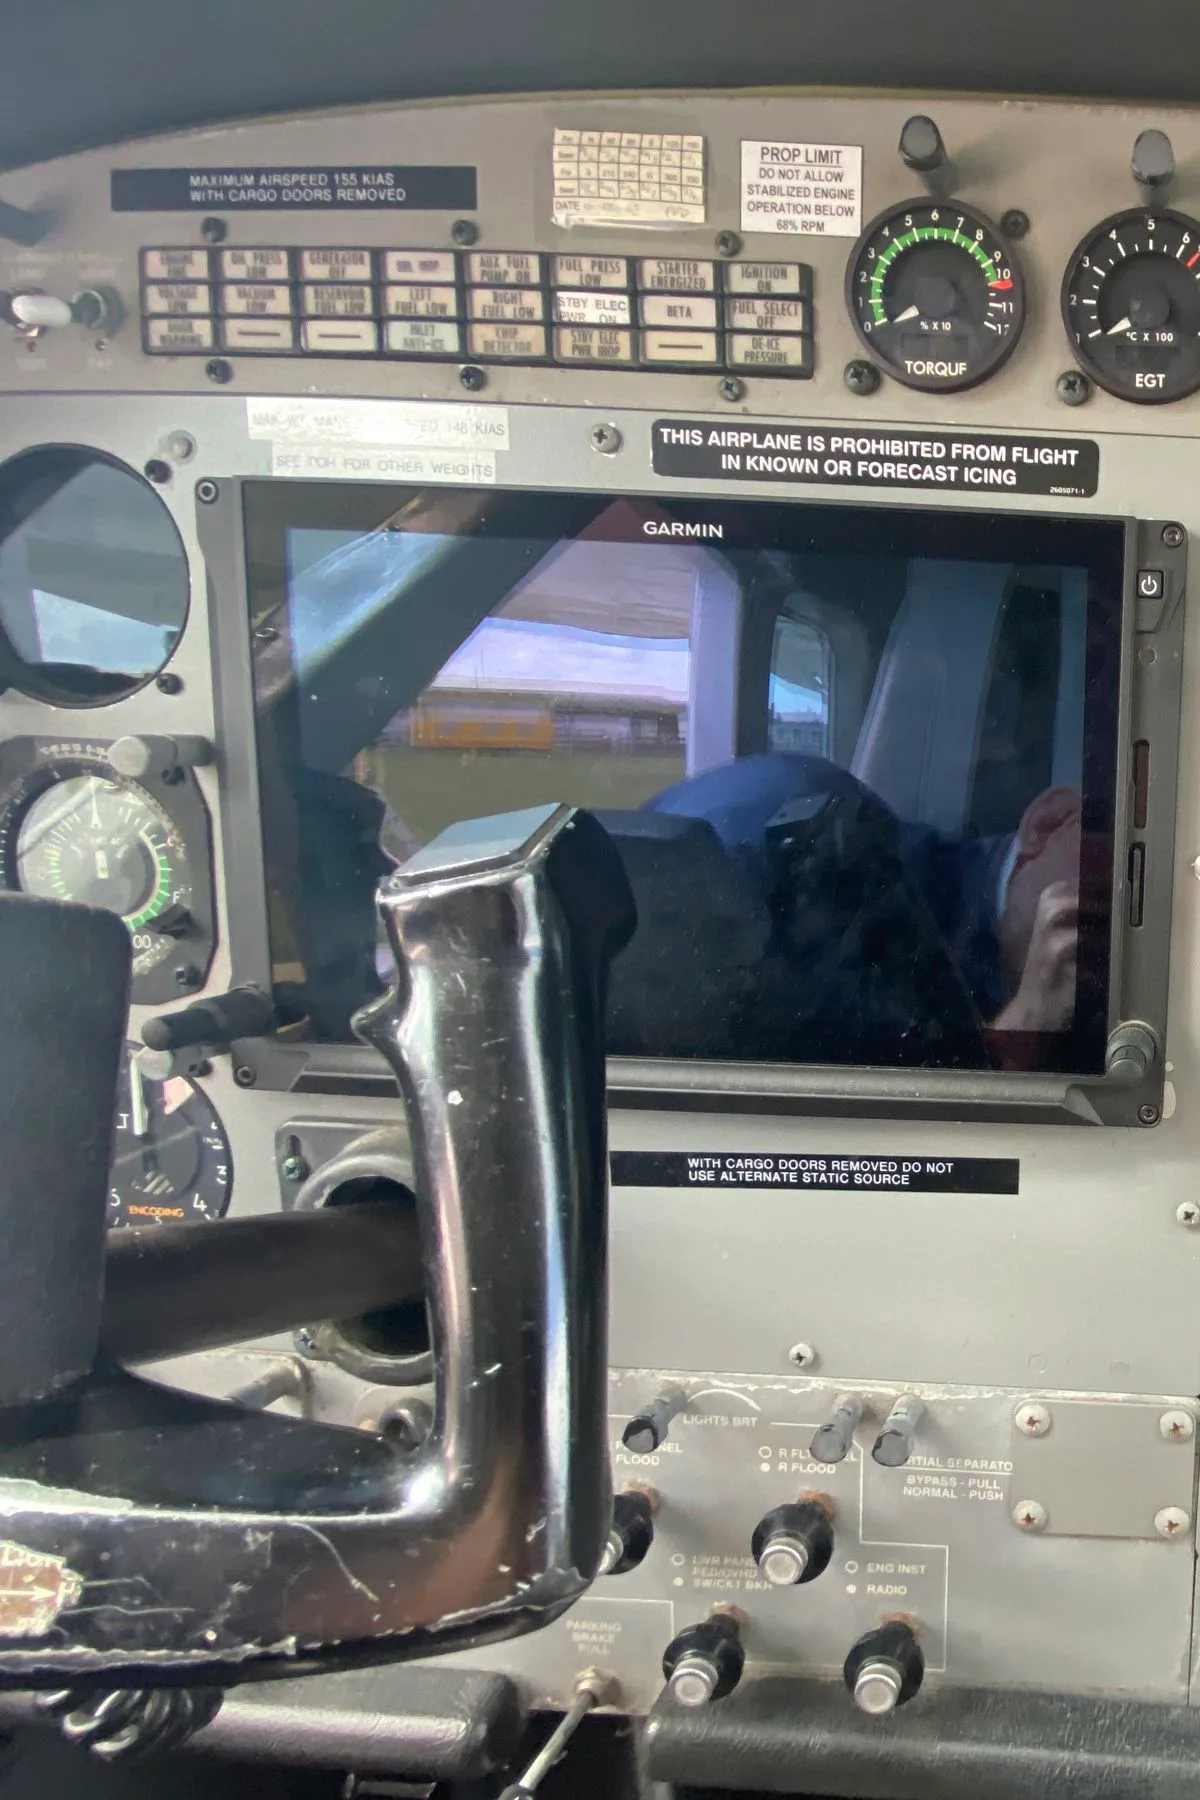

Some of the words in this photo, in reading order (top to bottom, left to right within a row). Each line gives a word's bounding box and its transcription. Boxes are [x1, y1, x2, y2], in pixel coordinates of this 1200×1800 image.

[761, 147, 800, 161] PROP
[805, 149, 842, 164] LIMIT
[189, 175, 254, 186] MAXIMUM
[259, 174, 327, 186] AIRSPEED
[333, 174, 357, 185] 155
[362, 173, 394, 185] KIAS
[759, 168, 775, 179] DO
[778, 169, 800, 180] NOT
[804, 170, 843, 182] ALLOW
[190, 190, 223, 201] WITH
[228, 189, 277, 201] CARGO
[282, 189, 332, 201] DOORS
[337, 189, 406, 201] REMOVED
[747, 184, 811, 198] STABILIZED
[814, 188, 855, 200] ENGINE
[747, 201, 811, 215] OPERATION
[814, 204, 855, 217] BELOW
[776, 220, 798, 231] 68%
[801, 221, 824, 232] RPM
[559, 261, 583, 273] FUEL
[591, 261, 621, 274] PRESS
[657, 262, 699, 275] STARTER
[741, 266, 788, 280] IGNITION
[579, 273, 600, 285] LOW
[651, 276, 706, 290] ENERGIZED
[757, 280, 772, 293] ON
[558, 296, 588, 308] STBY
[595, 299, 626, 311] ELEC
[733, 302, 758, 315] FUEL
[764, 303, 799, 317] SELECT
[560, 312, 586, 323] PWR
[599, 313, 617, 324] ON
[667, 305, 692, 318] BETA
[756, 316, 775, 329] OFF
[744, 351, 787, 364] PRESSURE
[1135, 374, 1165, 388] EGT
[660, 428, 703, 446] THIS
[707, 431, 801, 450] AIRPLANE
[807, 436, 825, 451] IS
[830, 437, 946, 459] PROHIBITED
[951, 443, 1006, 462] FROM
[1012, 447, 1079, 466] FLIGHT
[722, 454, 740, 470] IN
[746, 456, 818, 474] KNOWN
[824, 459, 851, 476] OR
[857, 461, 958, 482] FORECAST
[963, 467, 1017, 485] ICING
[643, 520, 723, 538] GARMIN
[688, 1158, 721, 1169] WITH
[725, 1159, 774, 1170] CARGO
[779, 1160, 827, 1171] DOORS
[831, 1161, 899, 1172] REMOVED
[902, 1162, 922, 1173] DO
[927, 1163, 954, 1173] NOT
[689, 1171, 715, 1181] USE
[720, 1171, 798, 1183] ALTERNATE
[802, 1173, 849, 1184] STATIC
[854, 1174, 910, 1185] SOURCE
[683, 1414, 728, 1426] LIGHTS
[732, 1416, 757, 1427] BRT
[615, 1455, 660, 1466] FLOOD
[779, 1462, 787, 1472] R
[791, 1463, 836, 1474] FLOOD
[907, 1475, 957, 1487] BYPASS
[968, 1478, 1000, 1489] PULL
[903, 1487, 957, 1499] NORMAL
[969, 1490, 1003, 1501] PUSH
[867, 1584, 908, 1595] RADIO
